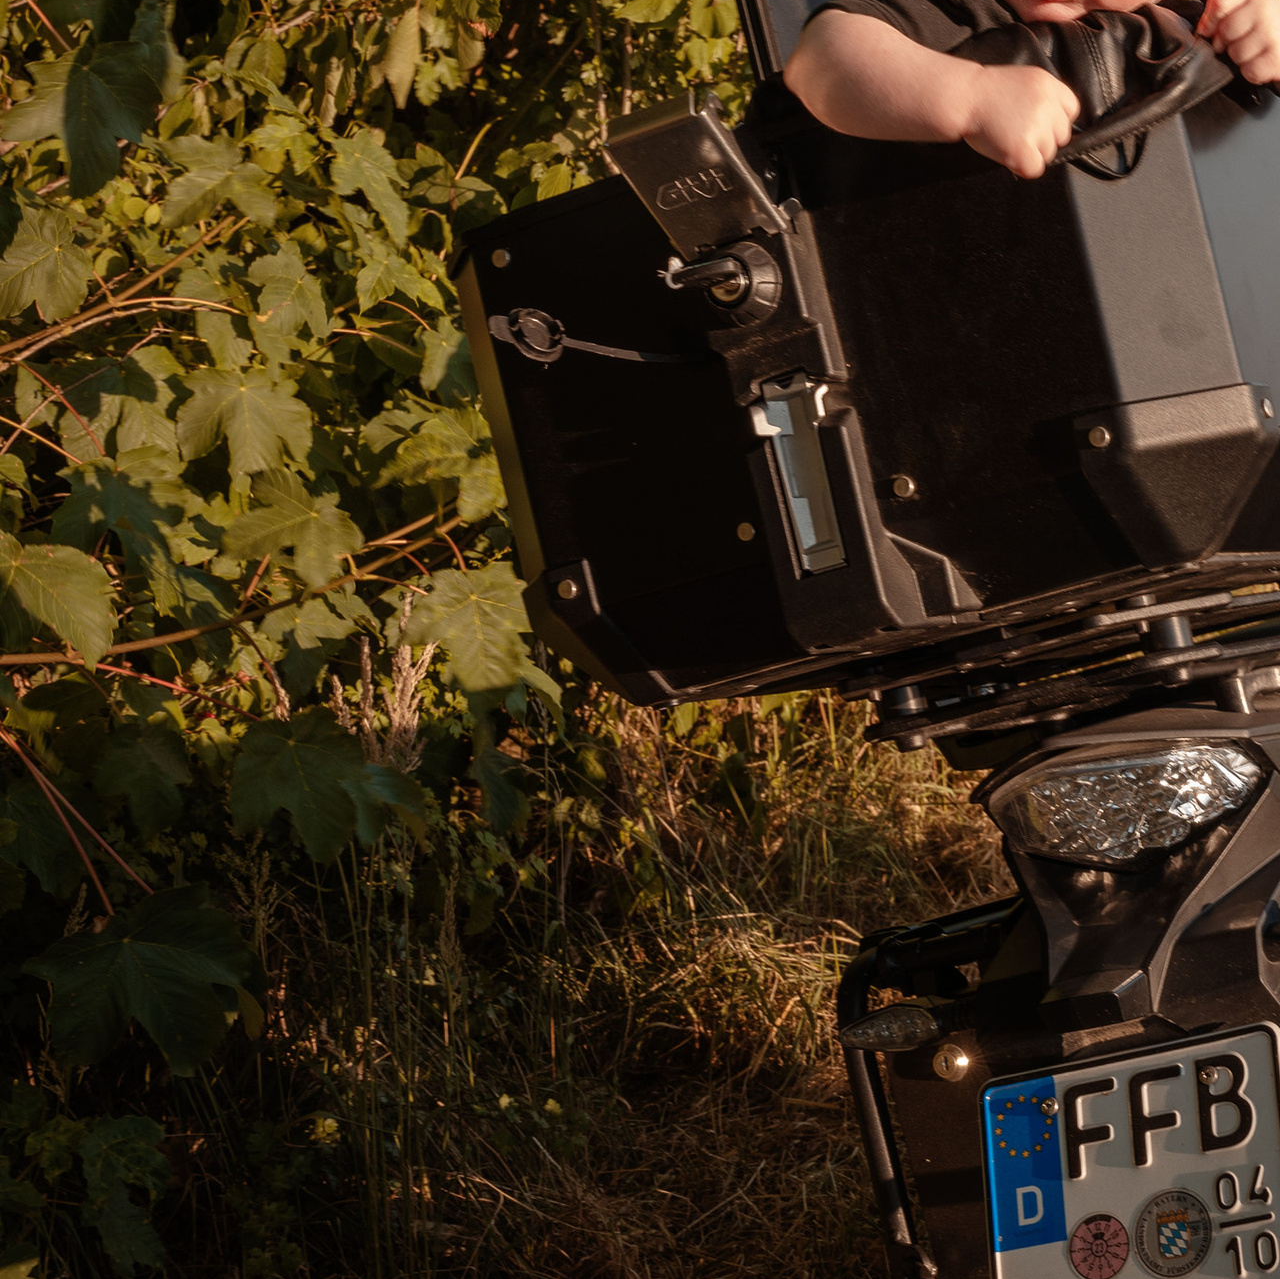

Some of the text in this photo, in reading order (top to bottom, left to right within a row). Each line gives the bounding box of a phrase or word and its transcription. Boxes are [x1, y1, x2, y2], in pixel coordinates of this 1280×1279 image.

[1064, 1052, 1255, 1180] FFB
[1016, 1185, 1044, 1227] D
[1216, 1165, 1272, 1211] 04
[1226, 1231, 1279, 1277] 10
